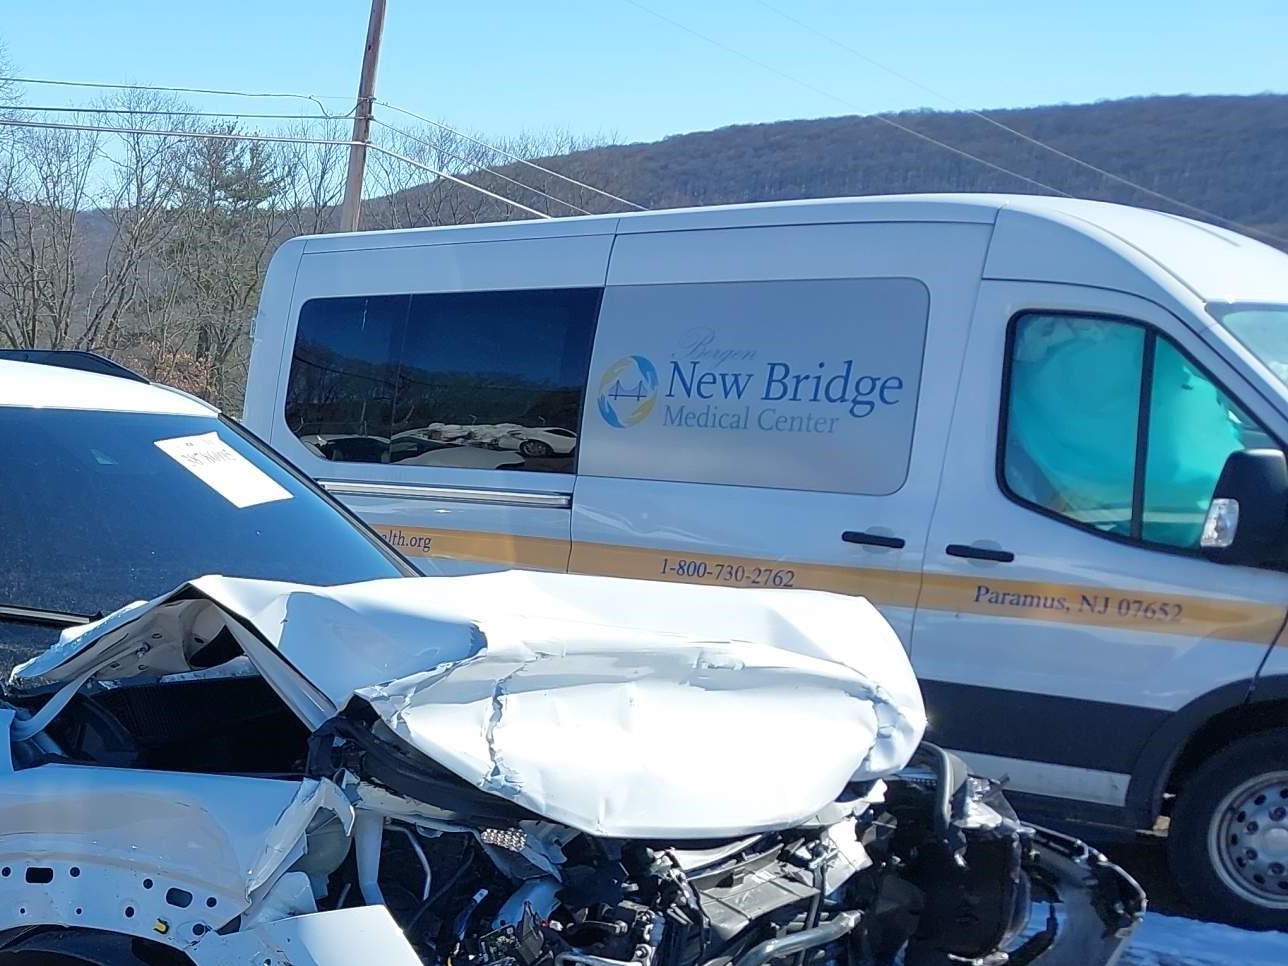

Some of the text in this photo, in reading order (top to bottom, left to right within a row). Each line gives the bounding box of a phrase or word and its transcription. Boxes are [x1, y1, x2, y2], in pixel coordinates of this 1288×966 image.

[672, 326, 759, 367] Bergen
[665, 360, 903, 418] New Bridge
[663, 404, 840, 434] Medical Center
[659, 558, 796, 588] 1-800-730-2762
[974, 585, 1183, 622] Paramus, NJ 07652
